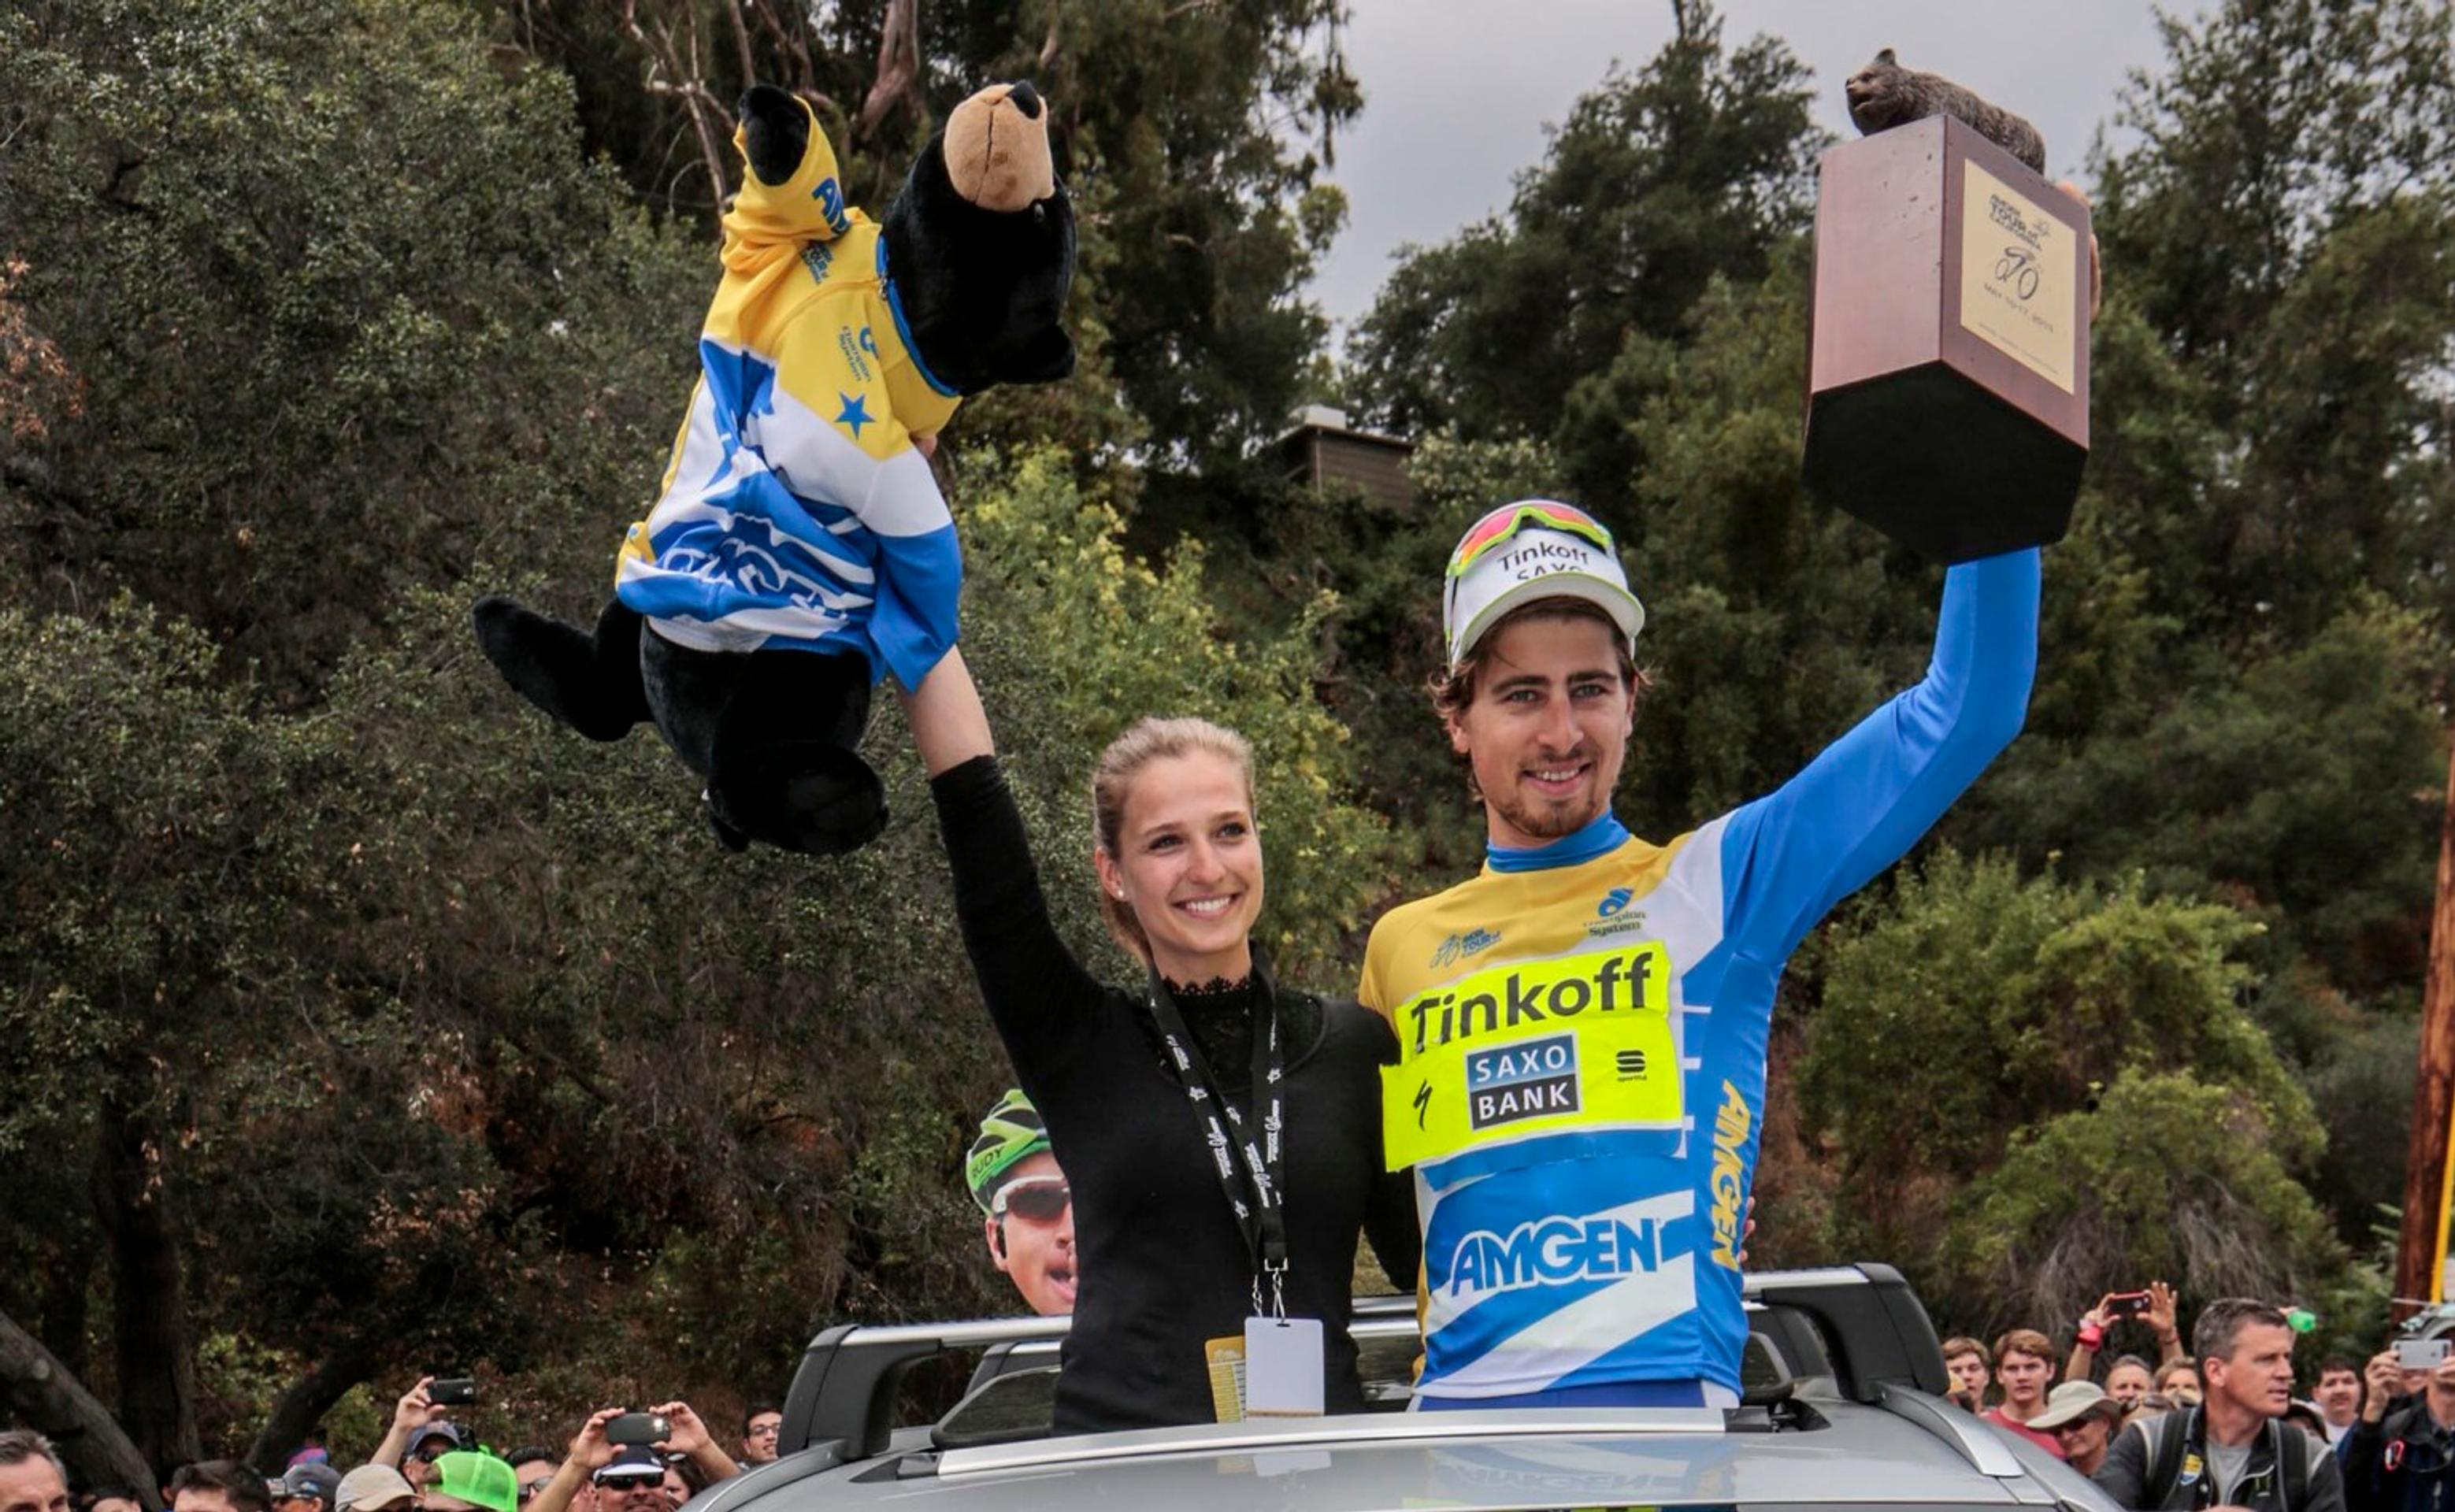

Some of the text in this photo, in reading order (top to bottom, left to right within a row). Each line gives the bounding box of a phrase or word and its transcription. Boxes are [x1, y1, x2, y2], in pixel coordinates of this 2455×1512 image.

[1411, 951, 1653, 1054] Tinkoff
[1475, 1043, 1568, 1084] SAXO
[1478, 1081, 1571, 1122] BANK
[1711, 1079, 1752, 1273] AMGEN
[1451, 1217, 1659, 1298] AMGEN
